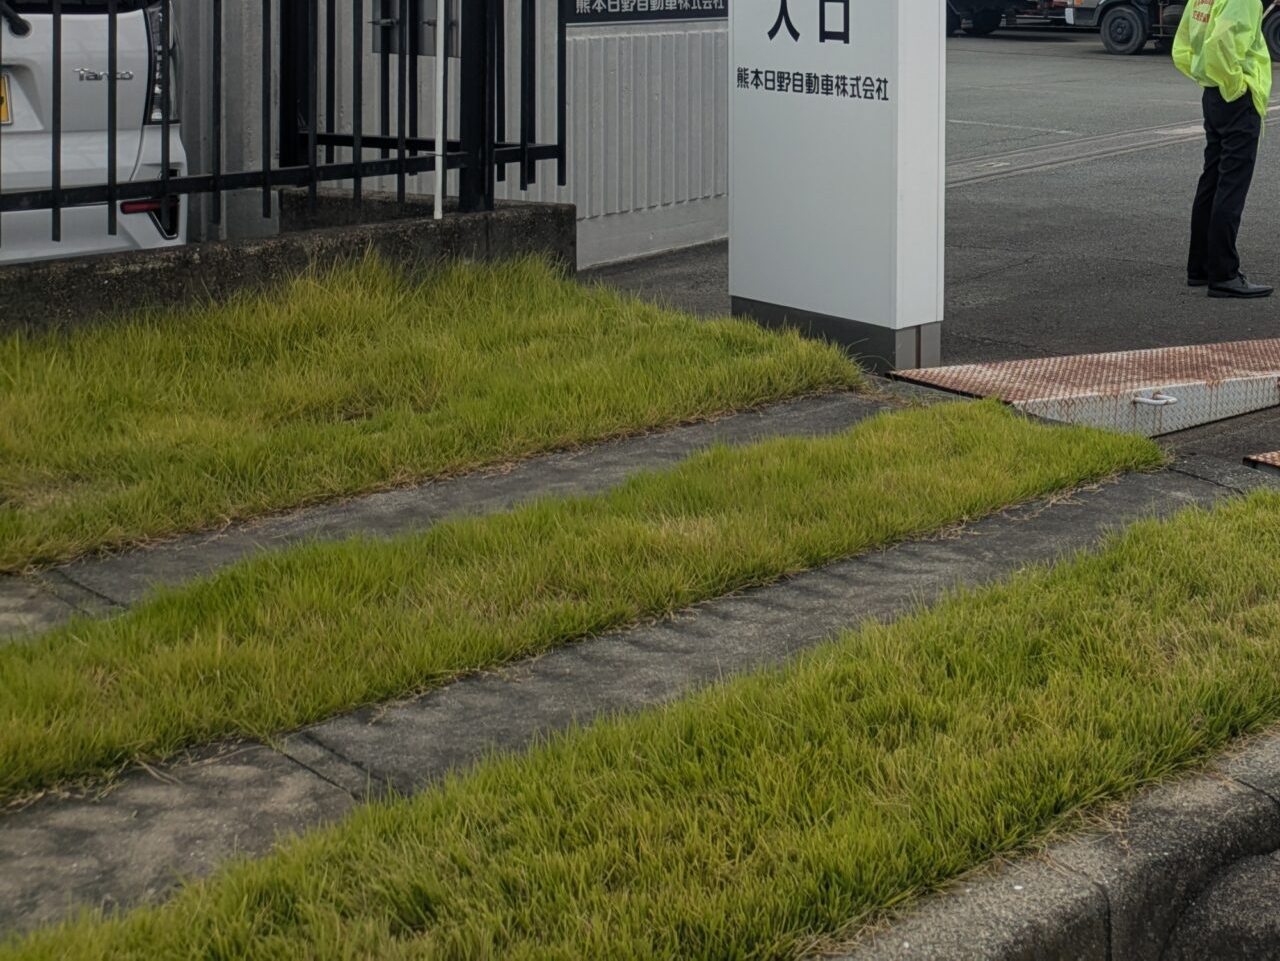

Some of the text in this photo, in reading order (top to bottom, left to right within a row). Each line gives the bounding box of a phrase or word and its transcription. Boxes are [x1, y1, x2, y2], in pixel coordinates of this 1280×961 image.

[736, 66, 890, 102] 熊本日野自動車株式会社
